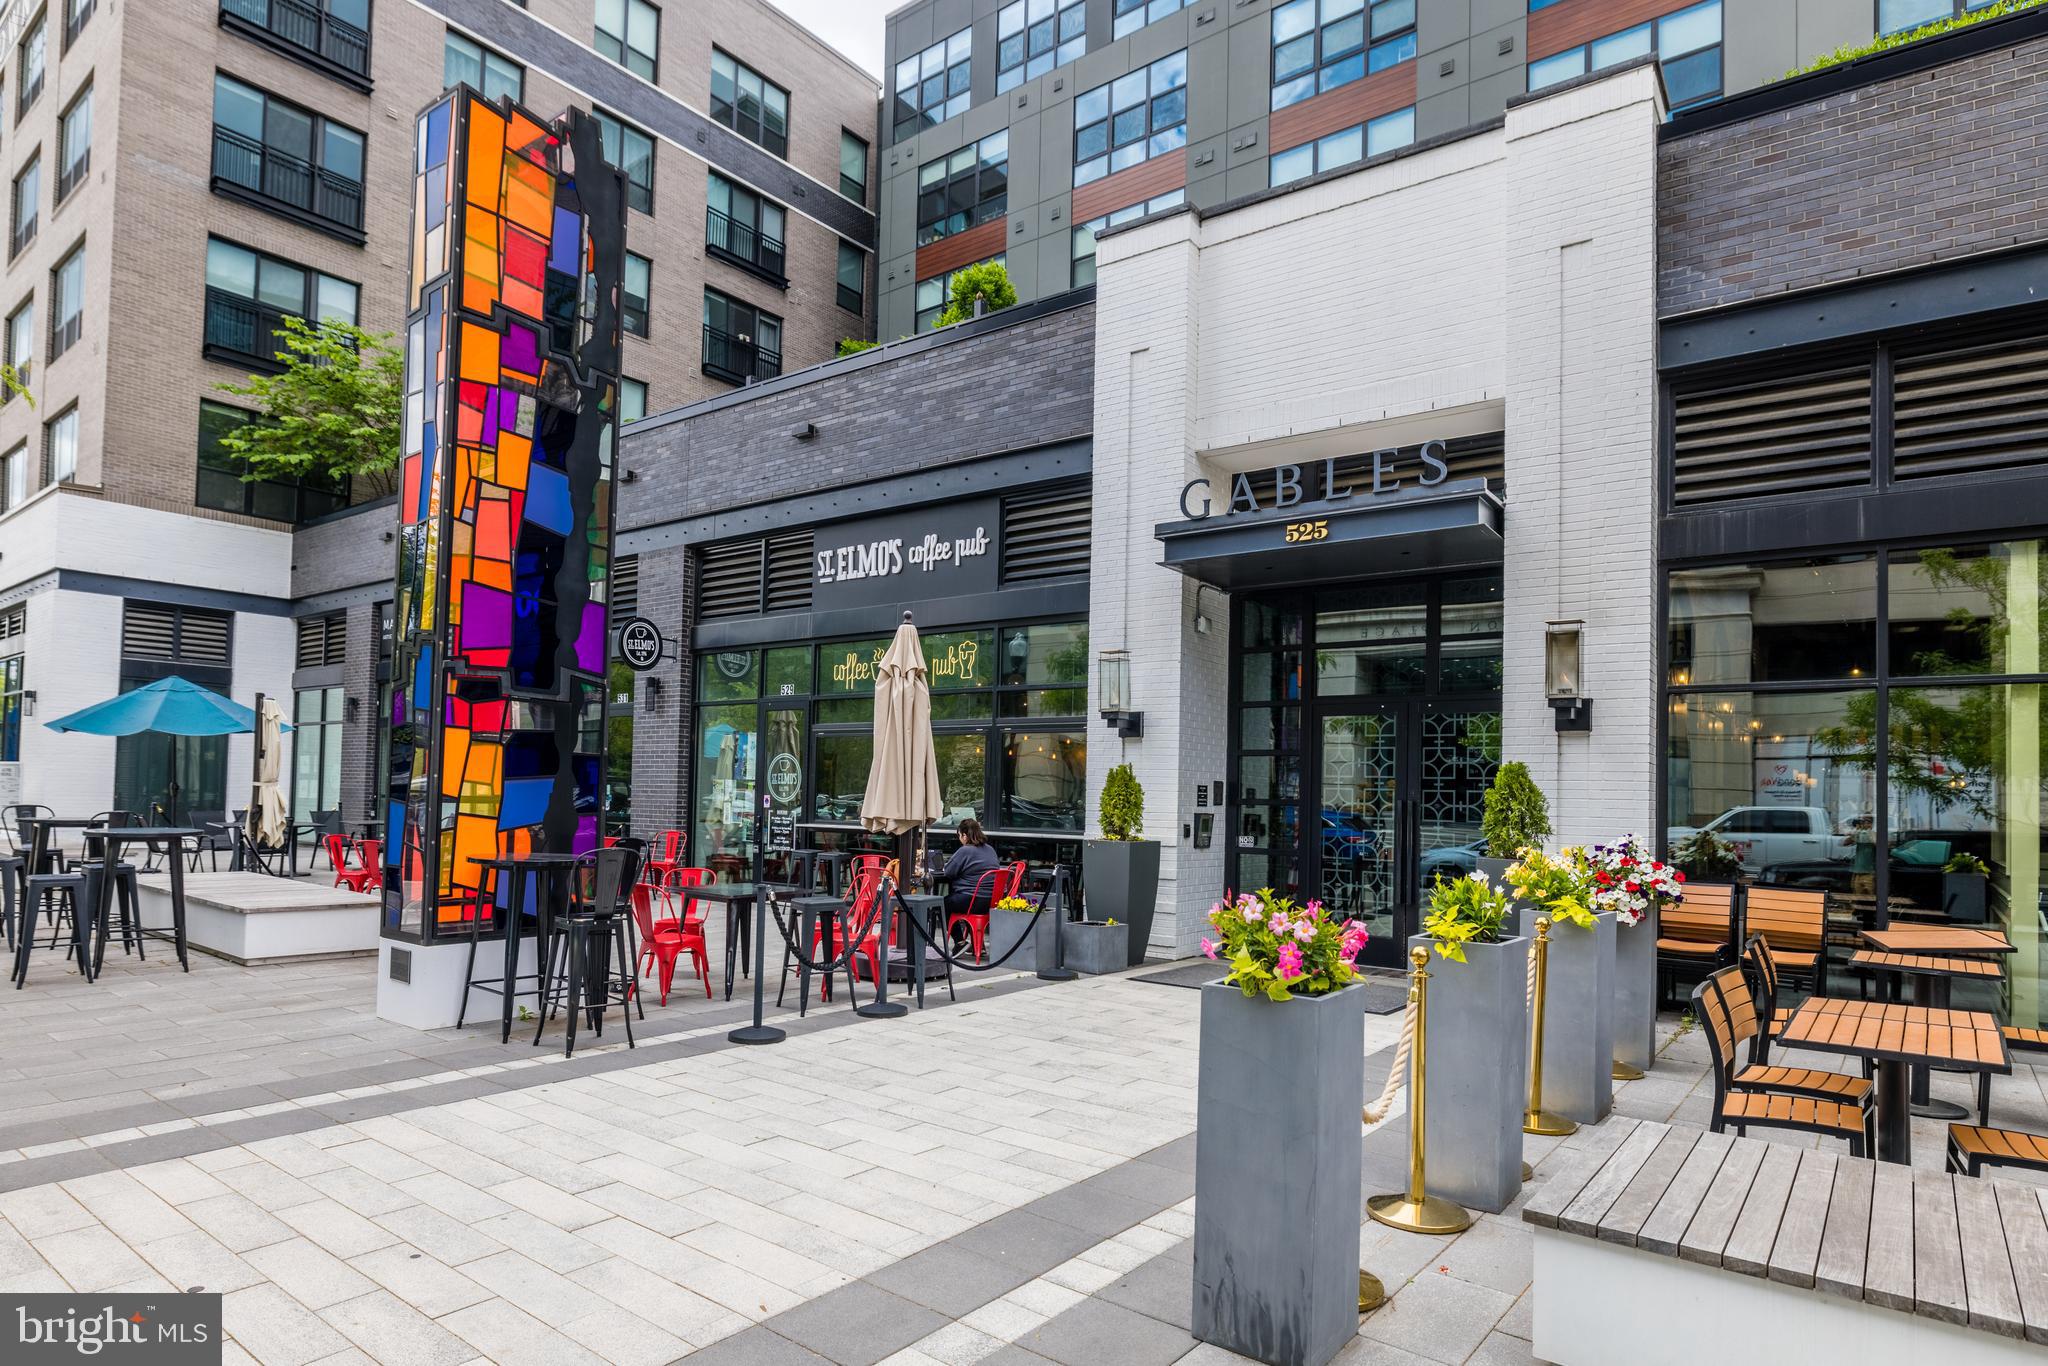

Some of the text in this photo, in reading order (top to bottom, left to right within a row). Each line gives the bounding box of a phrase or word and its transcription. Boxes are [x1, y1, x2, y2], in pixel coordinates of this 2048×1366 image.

[1180, 439, 1449, 521] GABLES
[1285, 519, 1329, 543] 525
[817, 526, 991, 583] ST. ELMO'S coffee pub
[634, 640, 655, 651] ELMO'S
[833, 645, 959, 690] coffee pub
[781, 684, 795, 696] 529
[778, 773, 797, 784] ELMO'S
